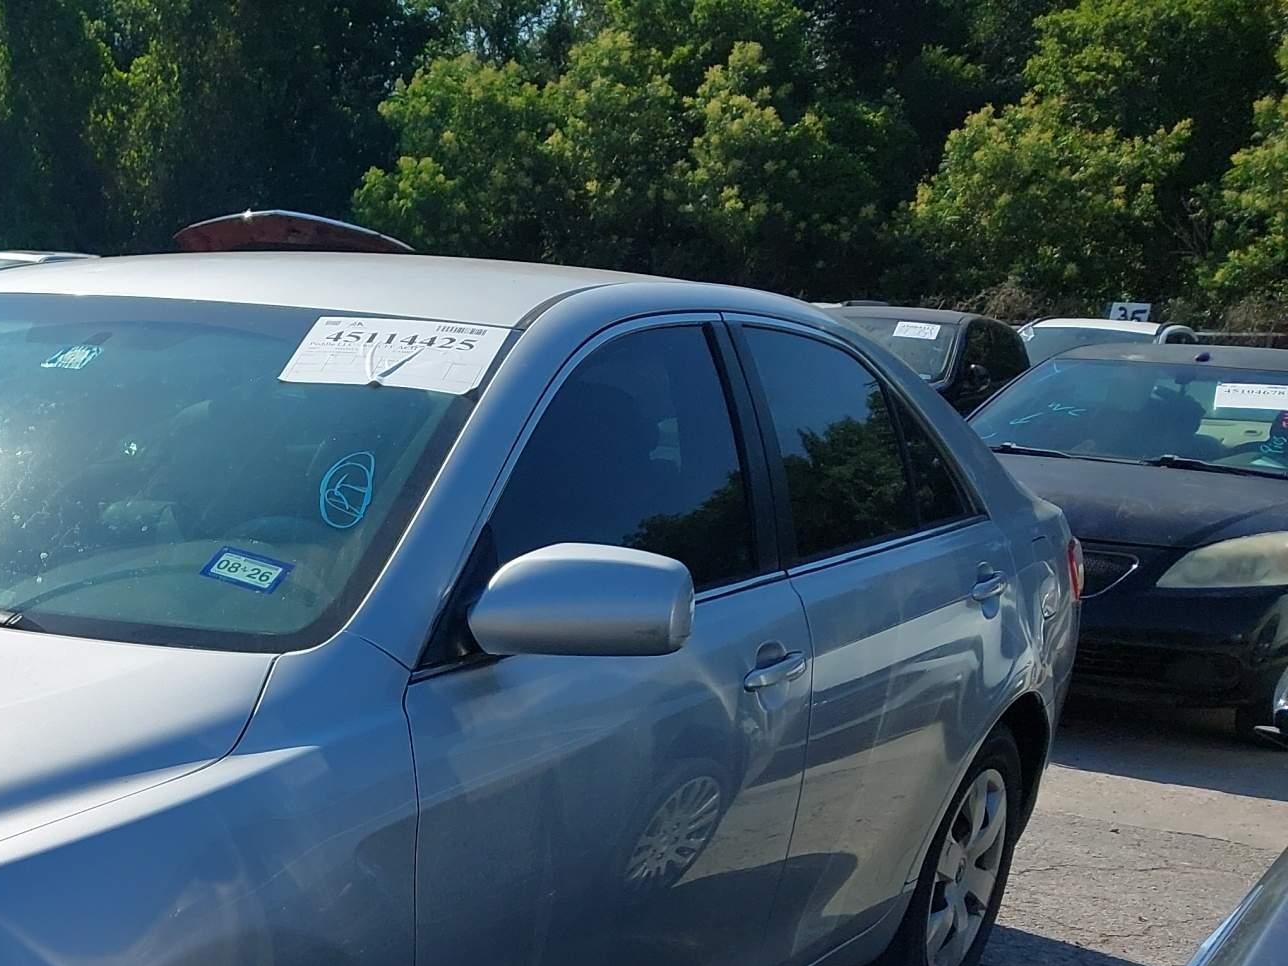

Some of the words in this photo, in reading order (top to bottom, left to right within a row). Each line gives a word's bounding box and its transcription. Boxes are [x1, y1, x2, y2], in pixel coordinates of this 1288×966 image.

[324, 330, 479, 351] 45114425
[216, 559, 242, 573] 08
[246, 567, 273, 582] 26
